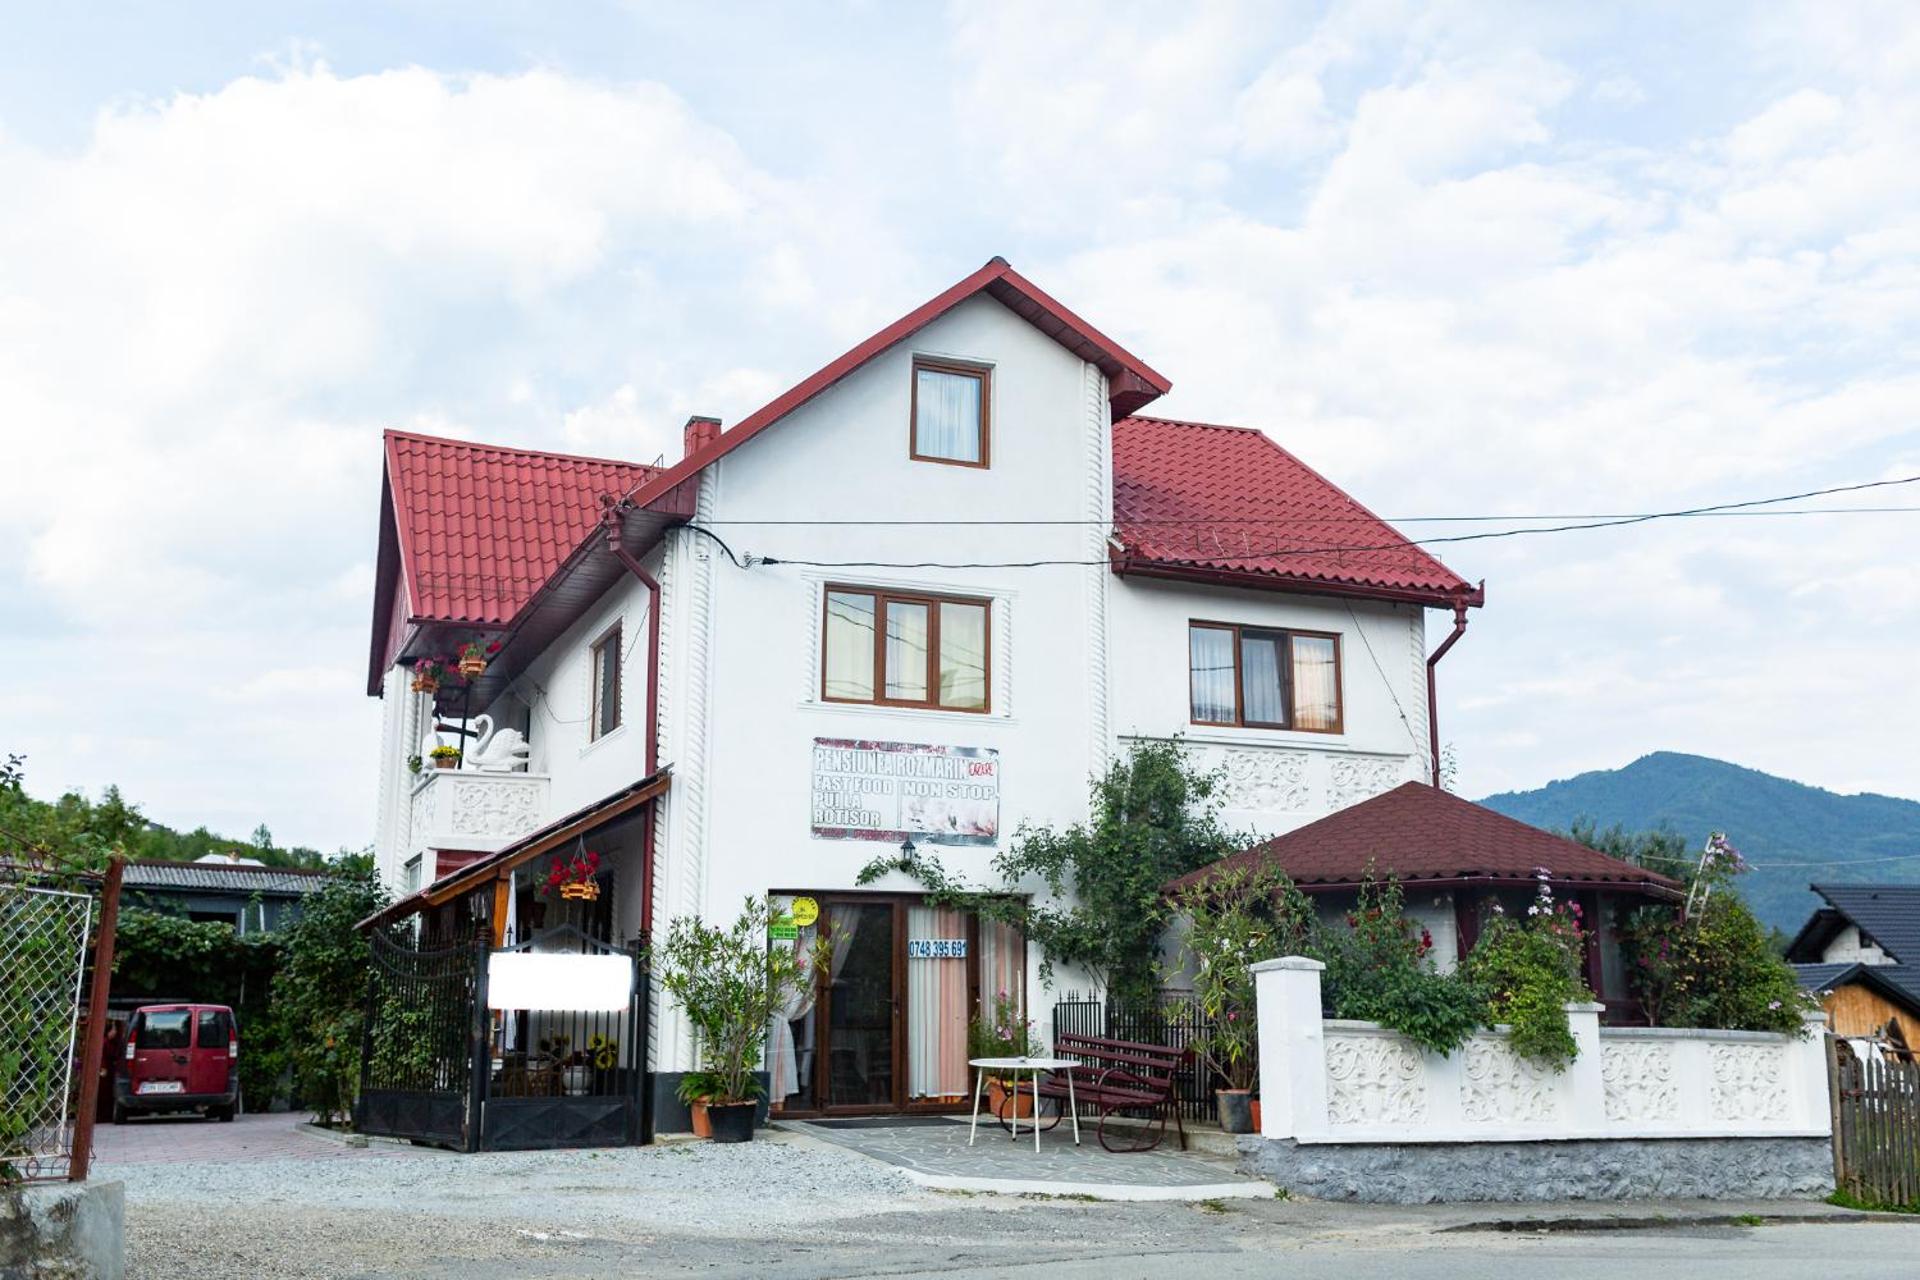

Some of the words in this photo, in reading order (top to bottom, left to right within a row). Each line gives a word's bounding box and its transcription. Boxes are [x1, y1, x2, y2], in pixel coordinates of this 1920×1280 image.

[814, 749, 893, 775] PENSIUNEA
[896, 754, 968, 781] ROZMARIN
[814, 775, 852, 792] FAST
[854, 778, 893, 795] FOOD
[902, 780, 943, 798] NON
[947, 784, 995, 801] STOP
[814, 791, 840, 809] PUI
[843, 793, 862, 810] LA
[813, 808, 881, 827] ROTISOR
[909, 940, 931, 957] 0748
[932, 940, 949, 957] 395
